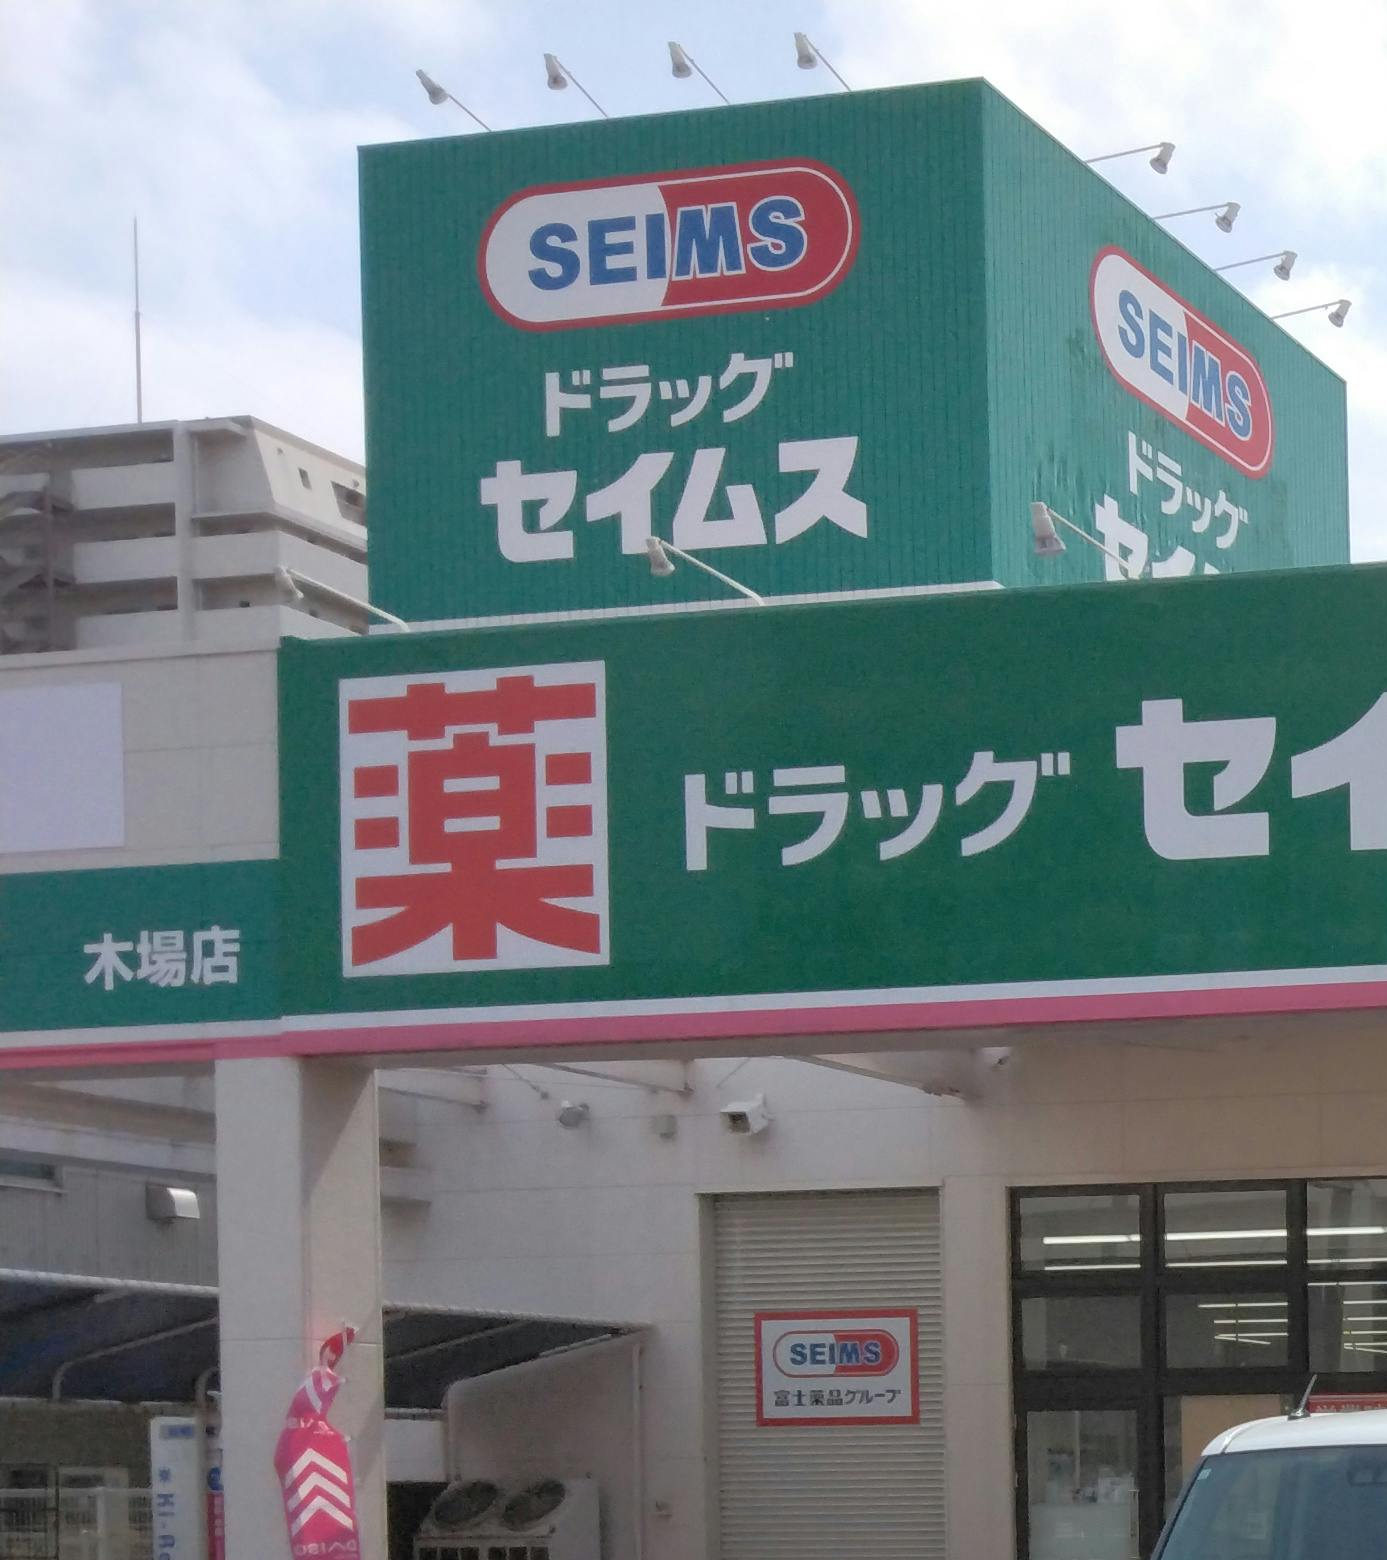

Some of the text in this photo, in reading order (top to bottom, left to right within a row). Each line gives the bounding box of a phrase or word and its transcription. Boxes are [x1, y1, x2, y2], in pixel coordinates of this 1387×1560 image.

[528, 196, 806, 291] SEIMS
[543, 351, 795, 438] ドラッグ
[1118, 288, 1253, 442] SEIMS
[480, 436, 868, 563] セイムス
[1128, 430, 1249, 549] ドラッグ
[348, 674, 601, 967] 薬
[684, 750, 1071, 872] ドラッグ
[83, 925, 241, 992] 木場店
[773, 1388, 902, 1407] 富士薬品グループ
[789, 1341, 882, 1366] SEIMS
